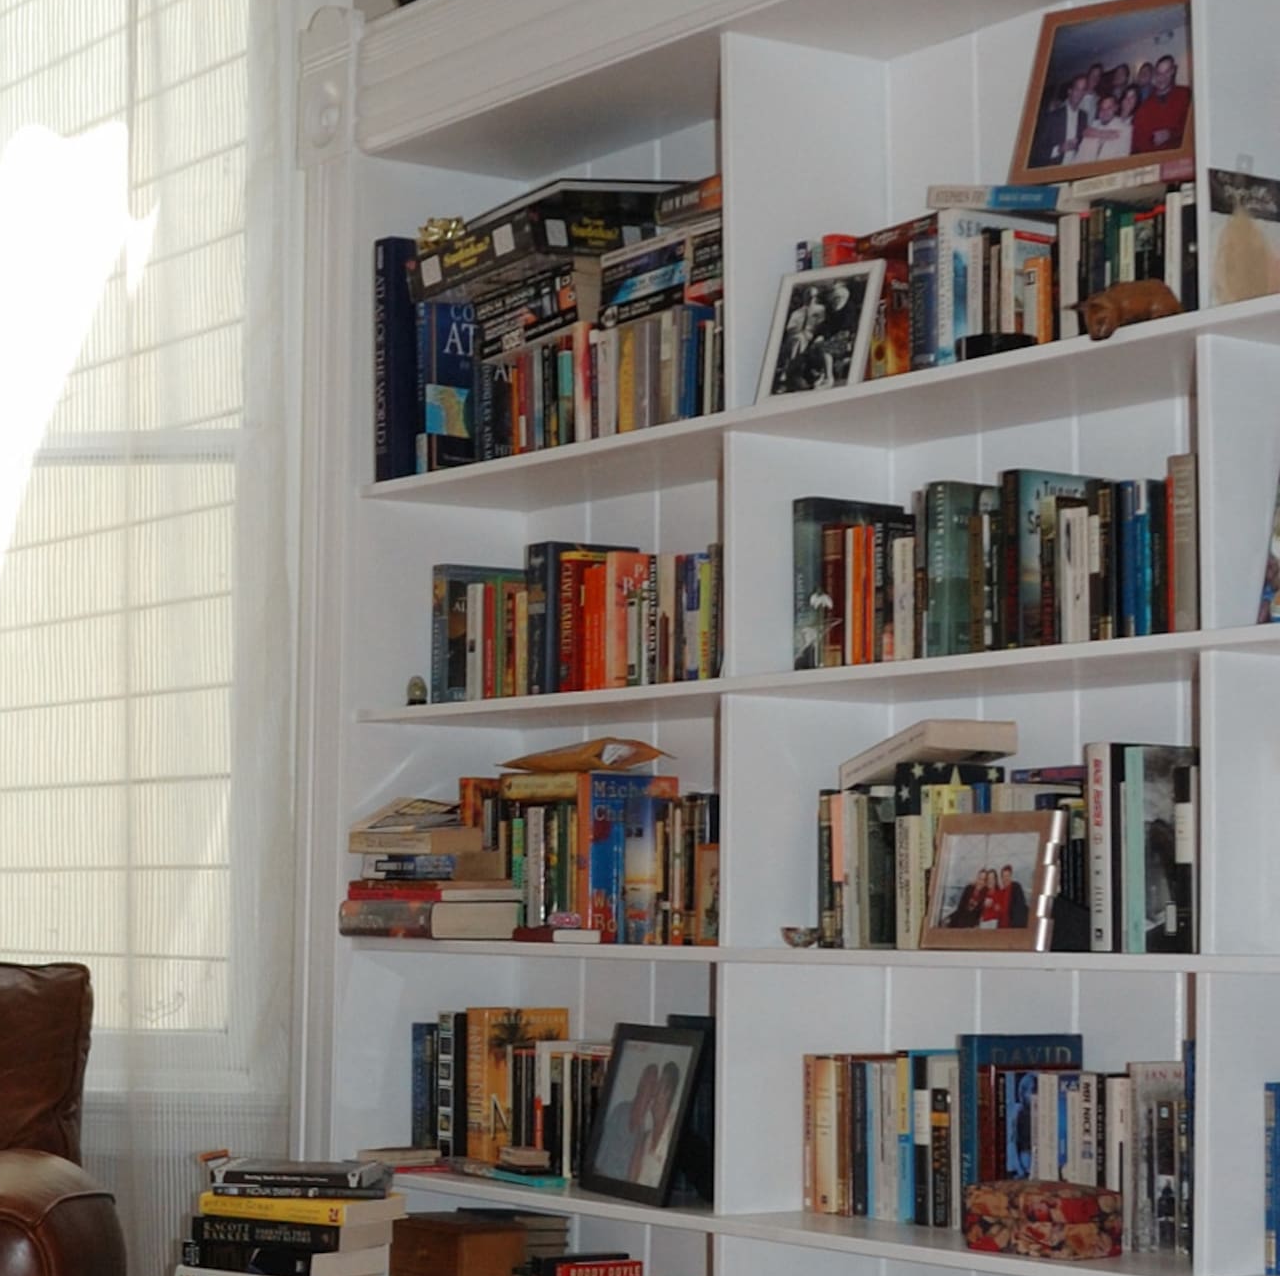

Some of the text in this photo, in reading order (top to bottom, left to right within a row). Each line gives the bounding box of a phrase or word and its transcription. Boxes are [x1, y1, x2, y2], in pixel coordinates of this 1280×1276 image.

[375, 275, 387, 444] ATLAS OF THE WORLD
[992, 1047, 1072, 1064] DAVID
